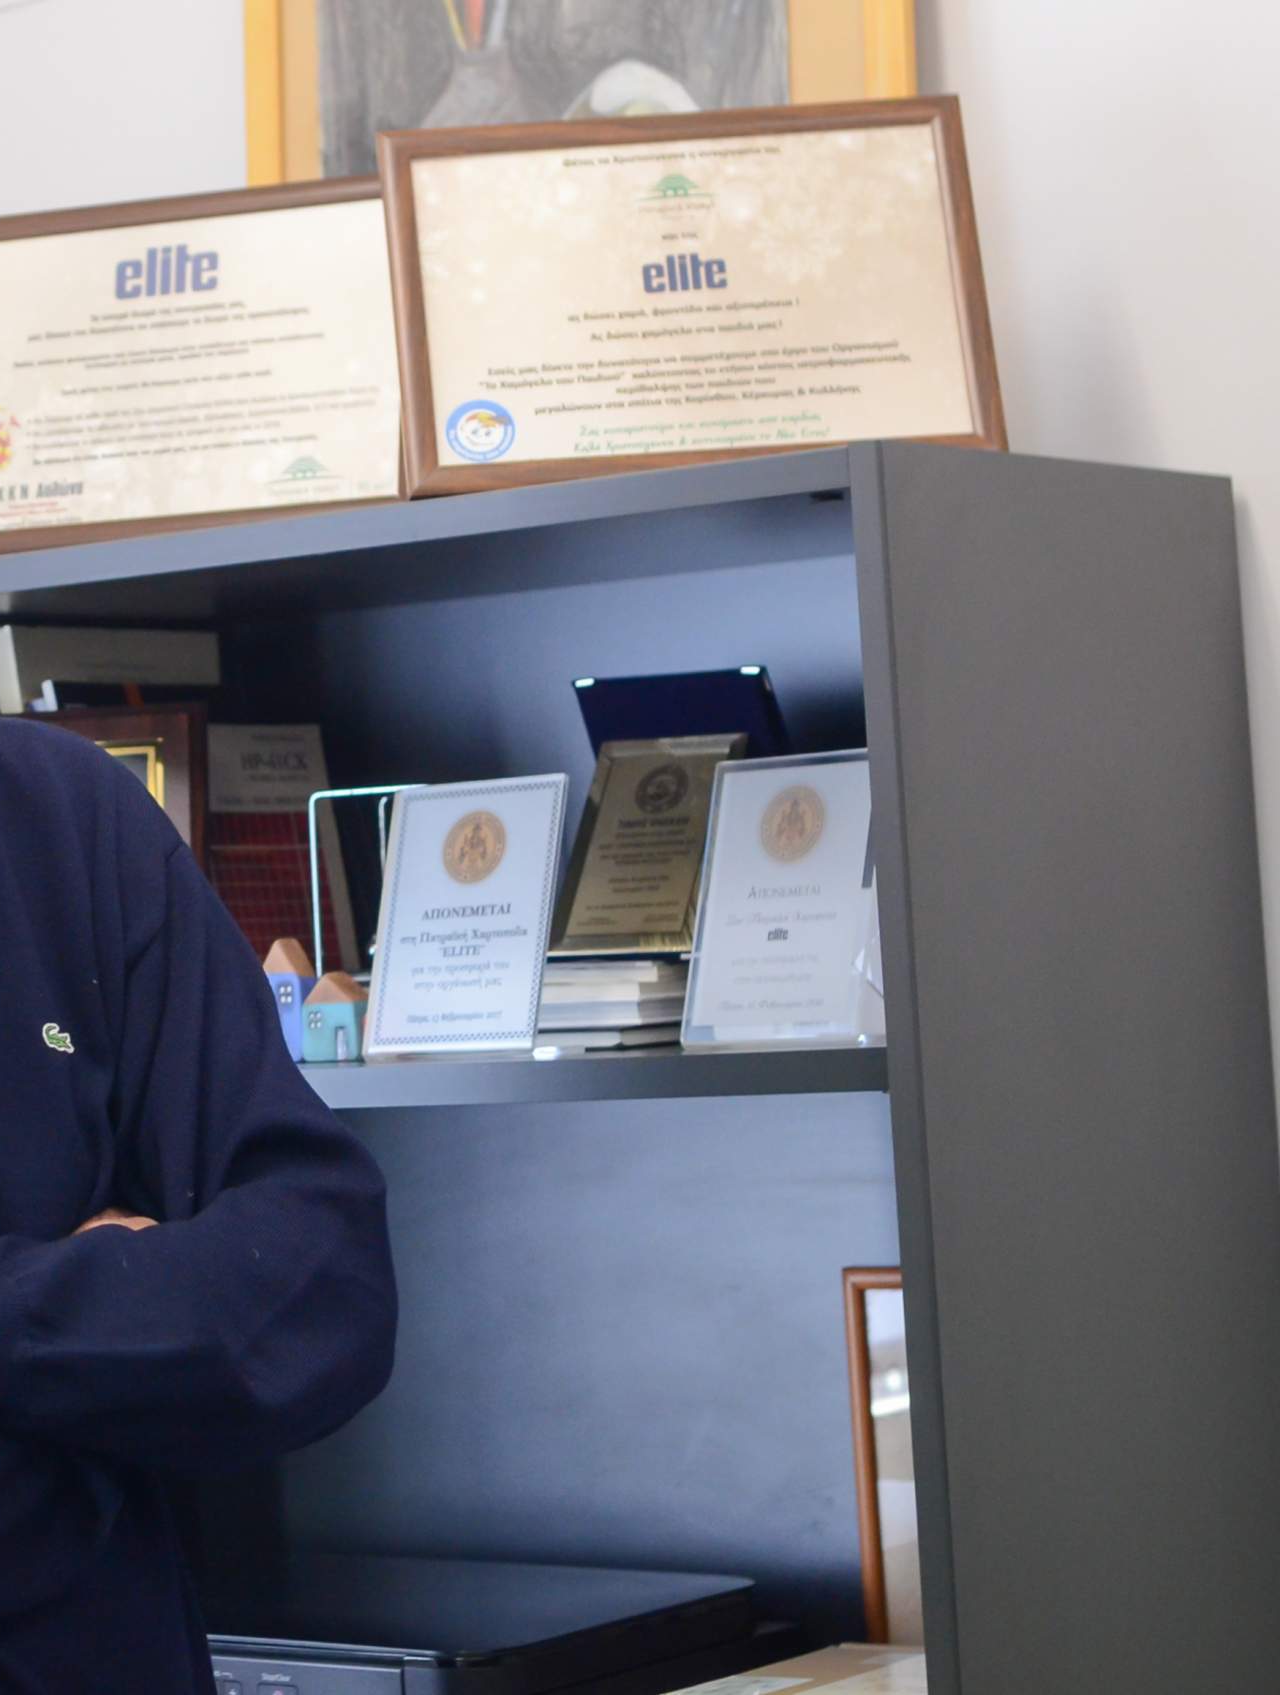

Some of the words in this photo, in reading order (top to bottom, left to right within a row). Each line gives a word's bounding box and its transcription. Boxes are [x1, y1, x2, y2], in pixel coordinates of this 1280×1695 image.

[115, 244, 219, 300] elite
[642, 253, 728, 294] elite
[421, 903, 512, 921] ΑΠΟΝΕΜΕΤΑΙ
